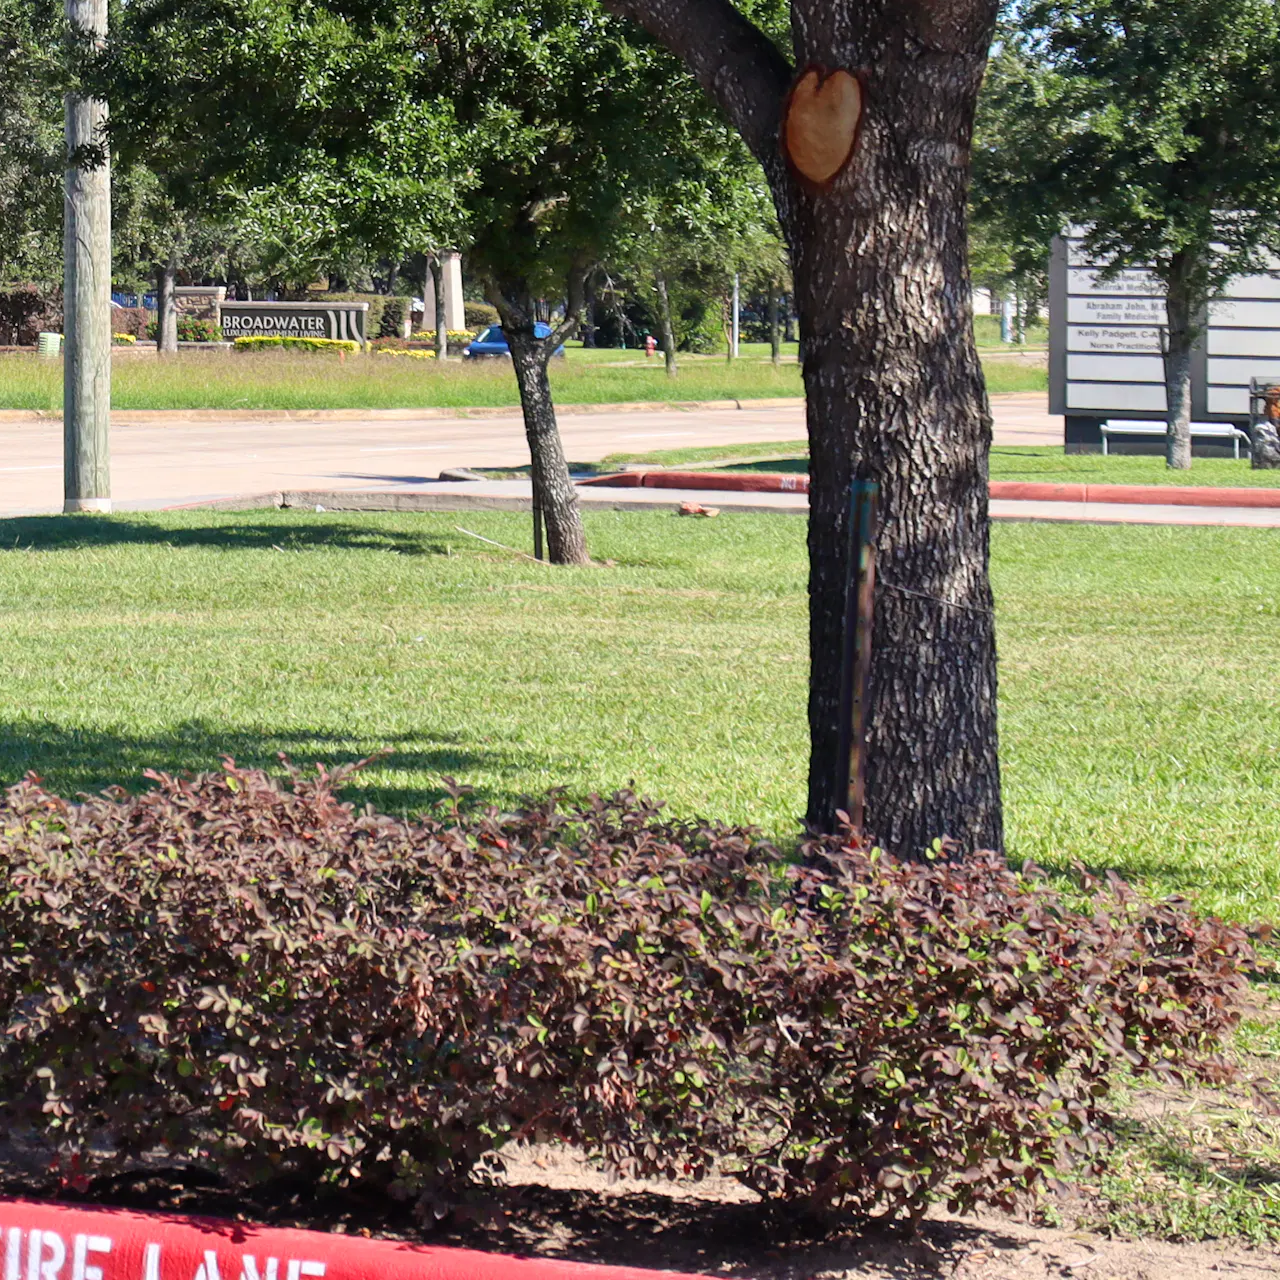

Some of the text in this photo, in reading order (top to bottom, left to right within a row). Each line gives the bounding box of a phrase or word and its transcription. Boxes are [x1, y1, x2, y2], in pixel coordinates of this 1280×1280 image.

[1086, 303, 1123, 311] Abraham
[1125, 302, 1149, 312] John,
[1096, 312, 1122, 322] Family
[223, 315, 325, 330] BROADWATER
[223, 329, 253, 337] LUXURY
[300, 330, 326, 338] LIVING
[1077, 330, 1100, 339] Kelly
[1102, 330, 1139, 340] Padgett,
